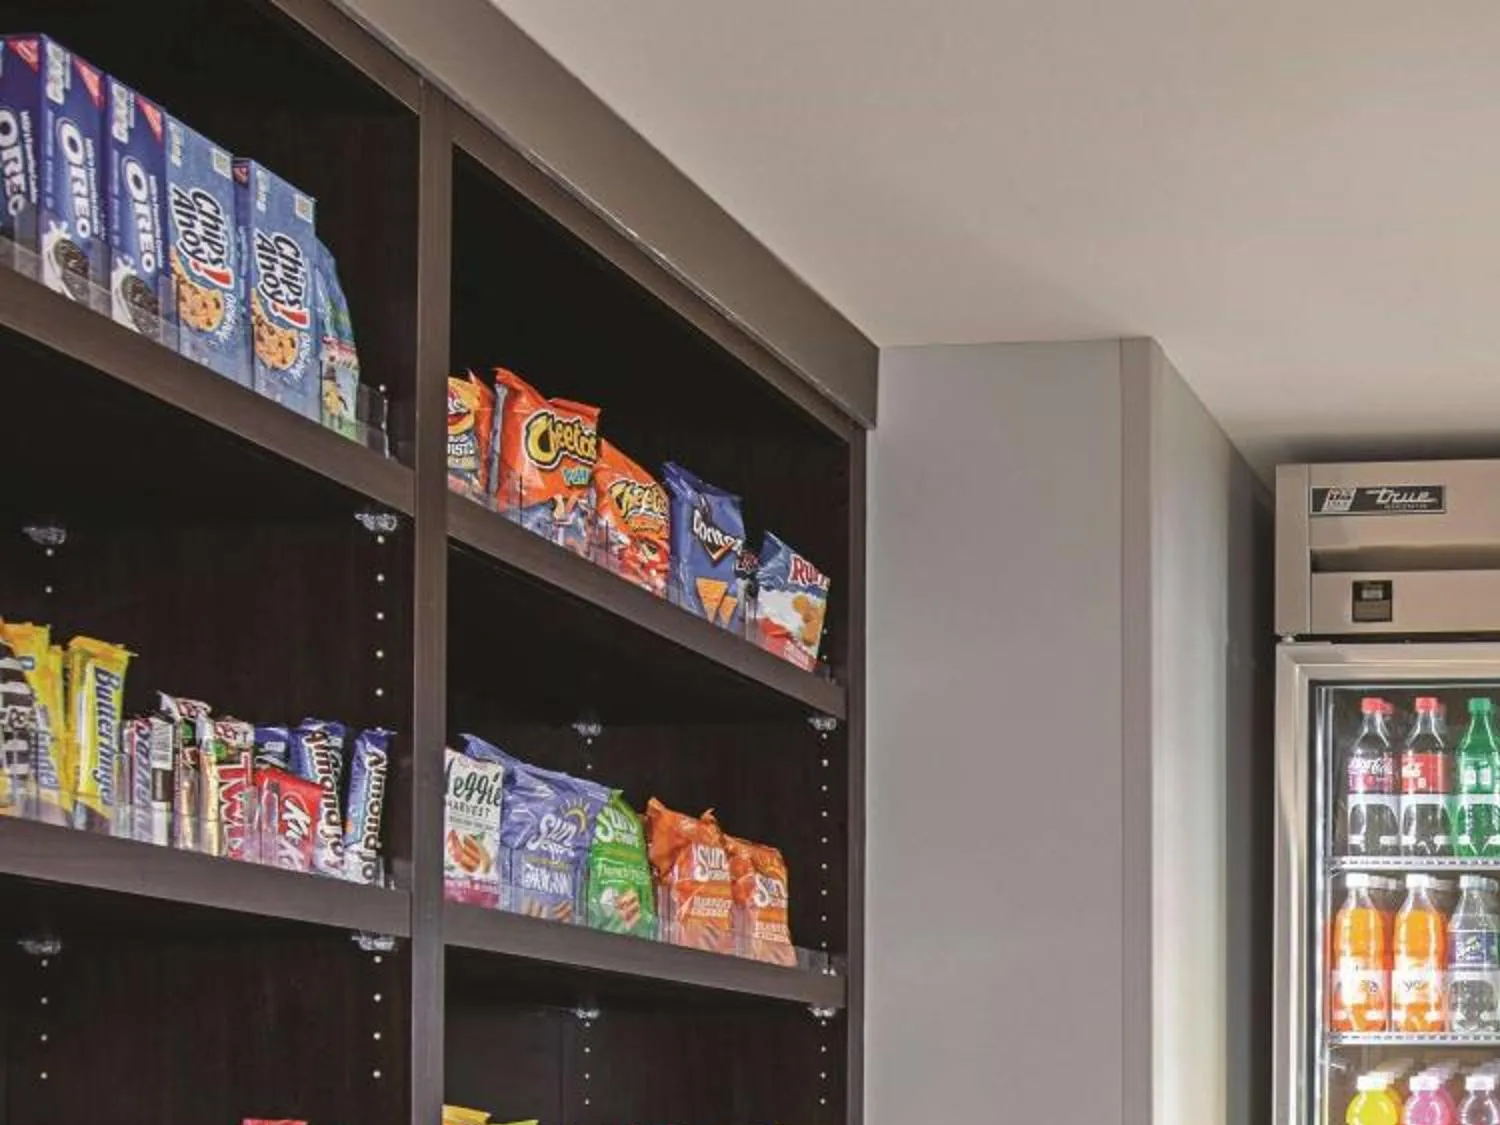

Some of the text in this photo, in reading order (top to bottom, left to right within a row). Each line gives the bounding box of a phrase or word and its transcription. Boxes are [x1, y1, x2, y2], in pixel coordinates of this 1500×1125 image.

[61, 122, 91, 238] OREO
[126, 160, 156, 273] OREO
[190, 188, 226, 269] Chips
[273, 233, 304, 308] Chips
[526, 411, 598, 467] Cheetos
